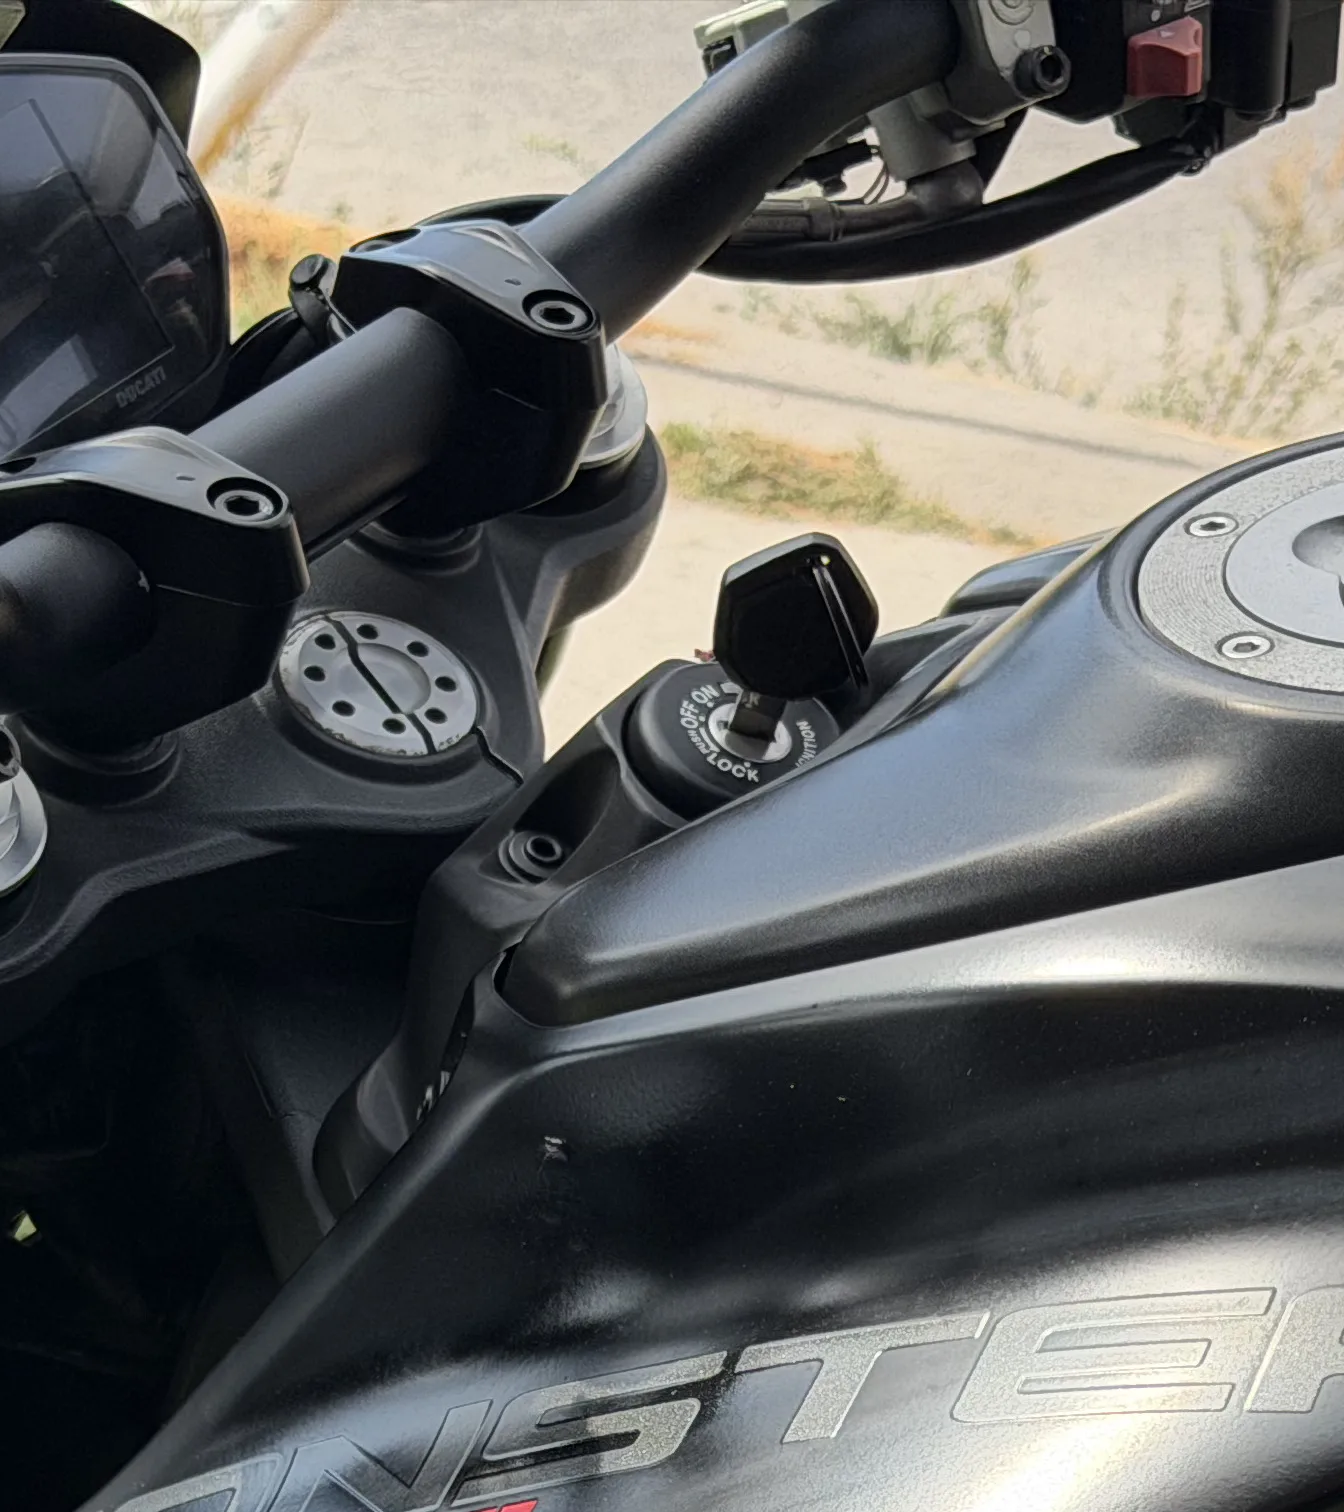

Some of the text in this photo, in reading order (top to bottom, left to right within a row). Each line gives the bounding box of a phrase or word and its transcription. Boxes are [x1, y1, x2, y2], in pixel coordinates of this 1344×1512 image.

[690, 684, 721, 704] ON
[679, 700, 699, 729] OFF
[687, 729, 711, 754] PUSH
[707, 753, 759, 782] LOCK
